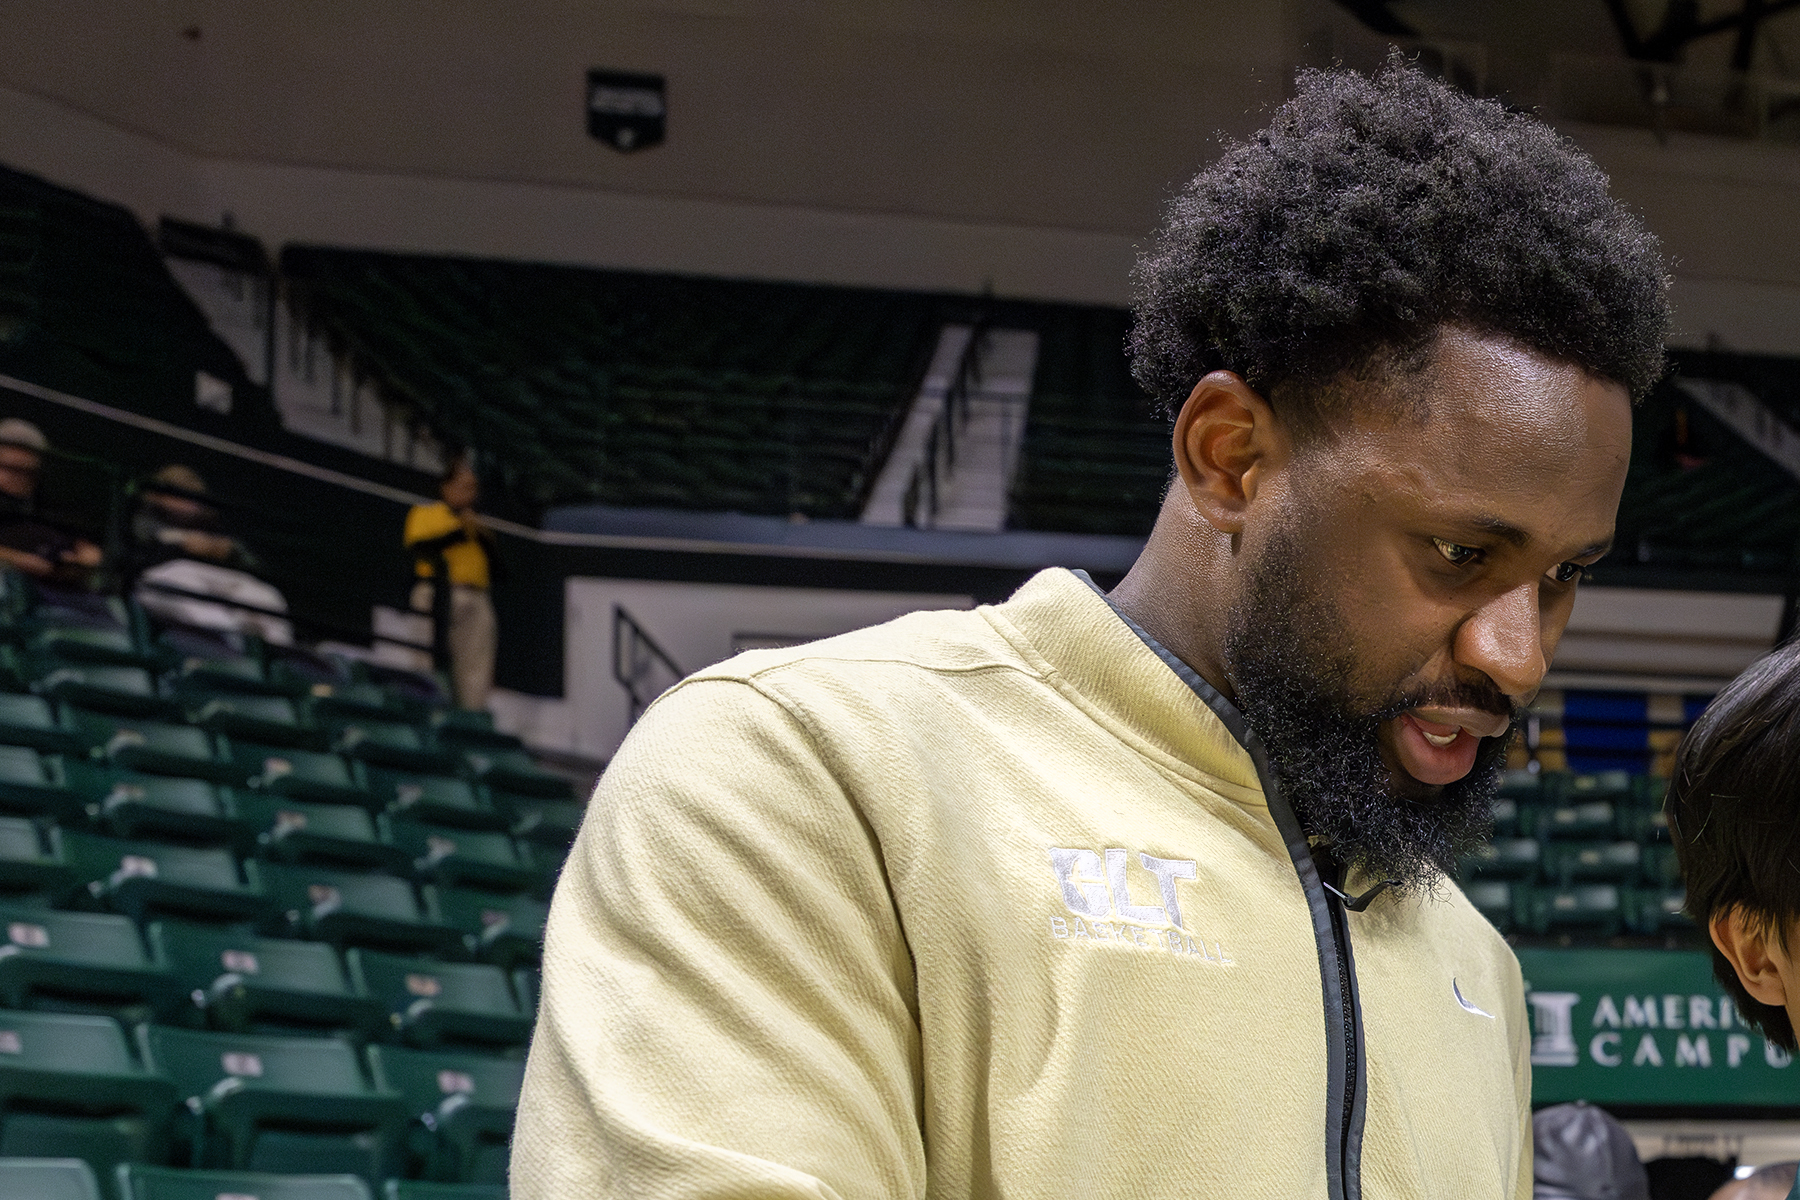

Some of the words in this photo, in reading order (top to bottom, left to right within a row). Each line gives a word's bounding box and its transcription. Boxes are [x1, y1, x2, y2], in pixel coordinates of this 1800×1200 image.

[1050, 916, 1232, 963] BASKETBALL
[1592, 994, 1742, 1029] AMERI
[1589, 1032, 1794, 1068] CAMPU
